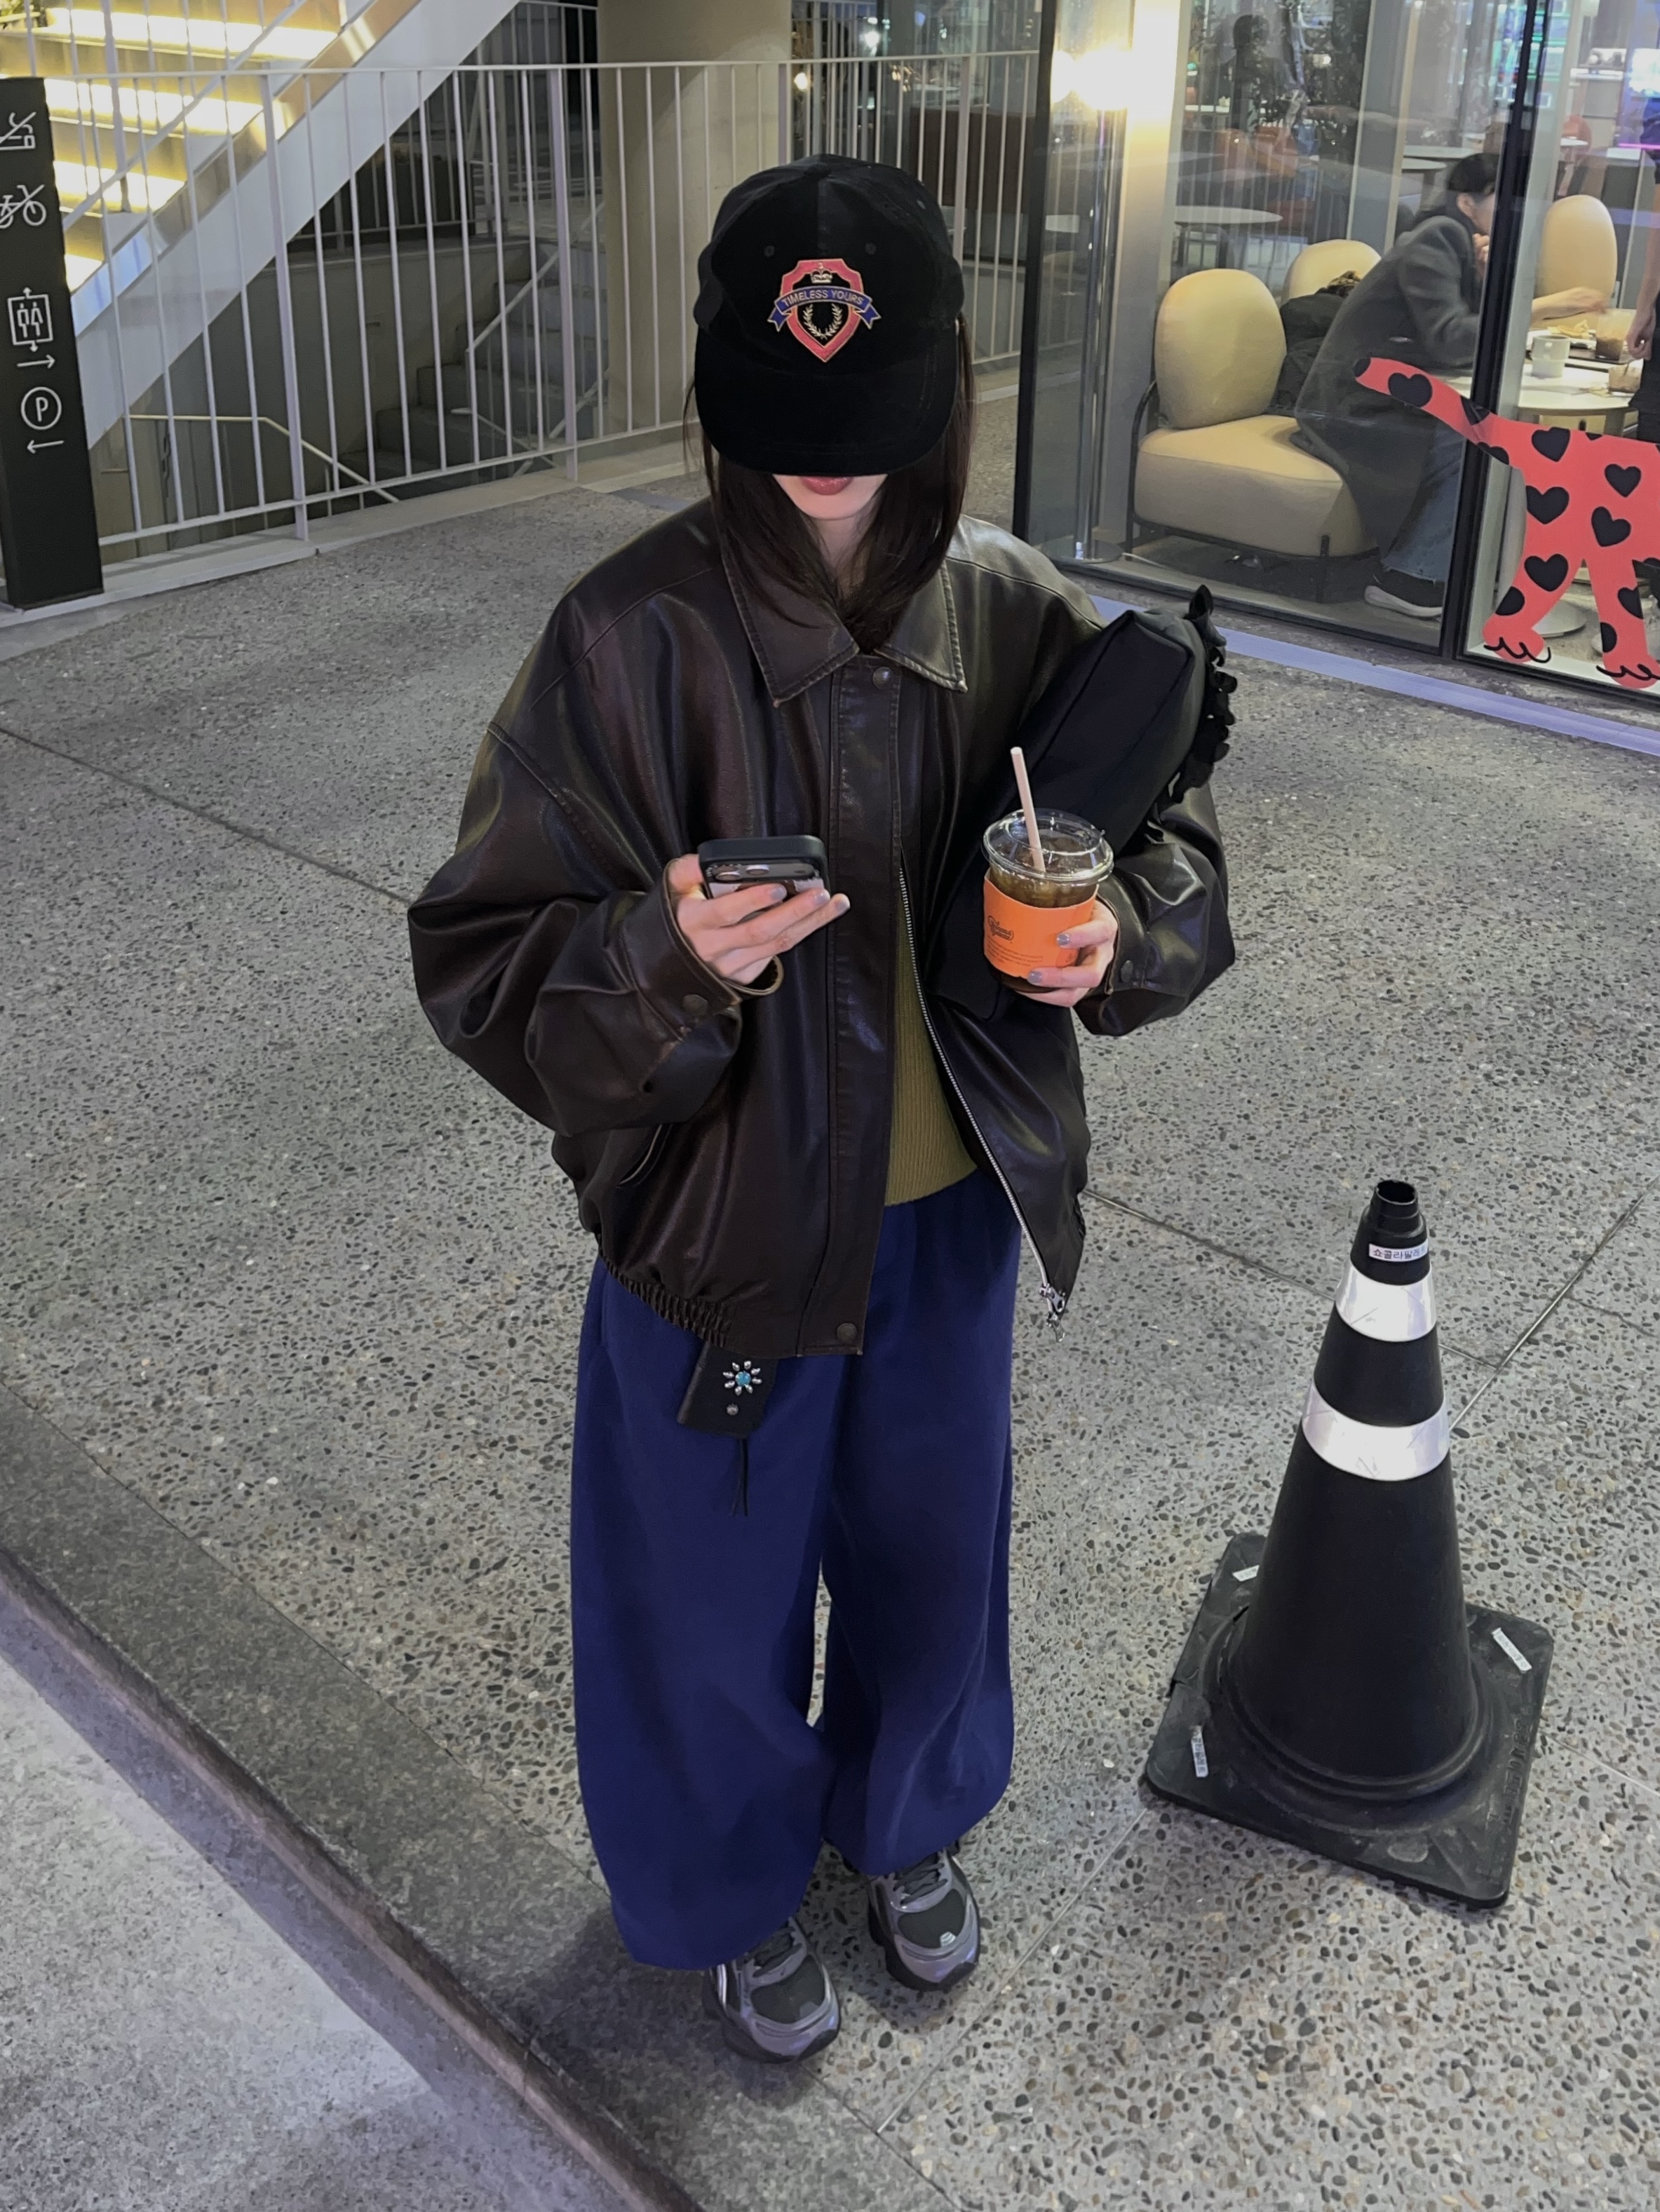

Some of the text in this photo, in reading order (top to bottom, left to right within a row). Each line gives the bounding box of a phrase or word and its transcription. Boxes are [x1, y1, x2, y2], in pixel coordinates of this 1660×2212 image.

[781, 290, 864, 307] TIMELESS YOURS
[36, 396, 48, 422] P
